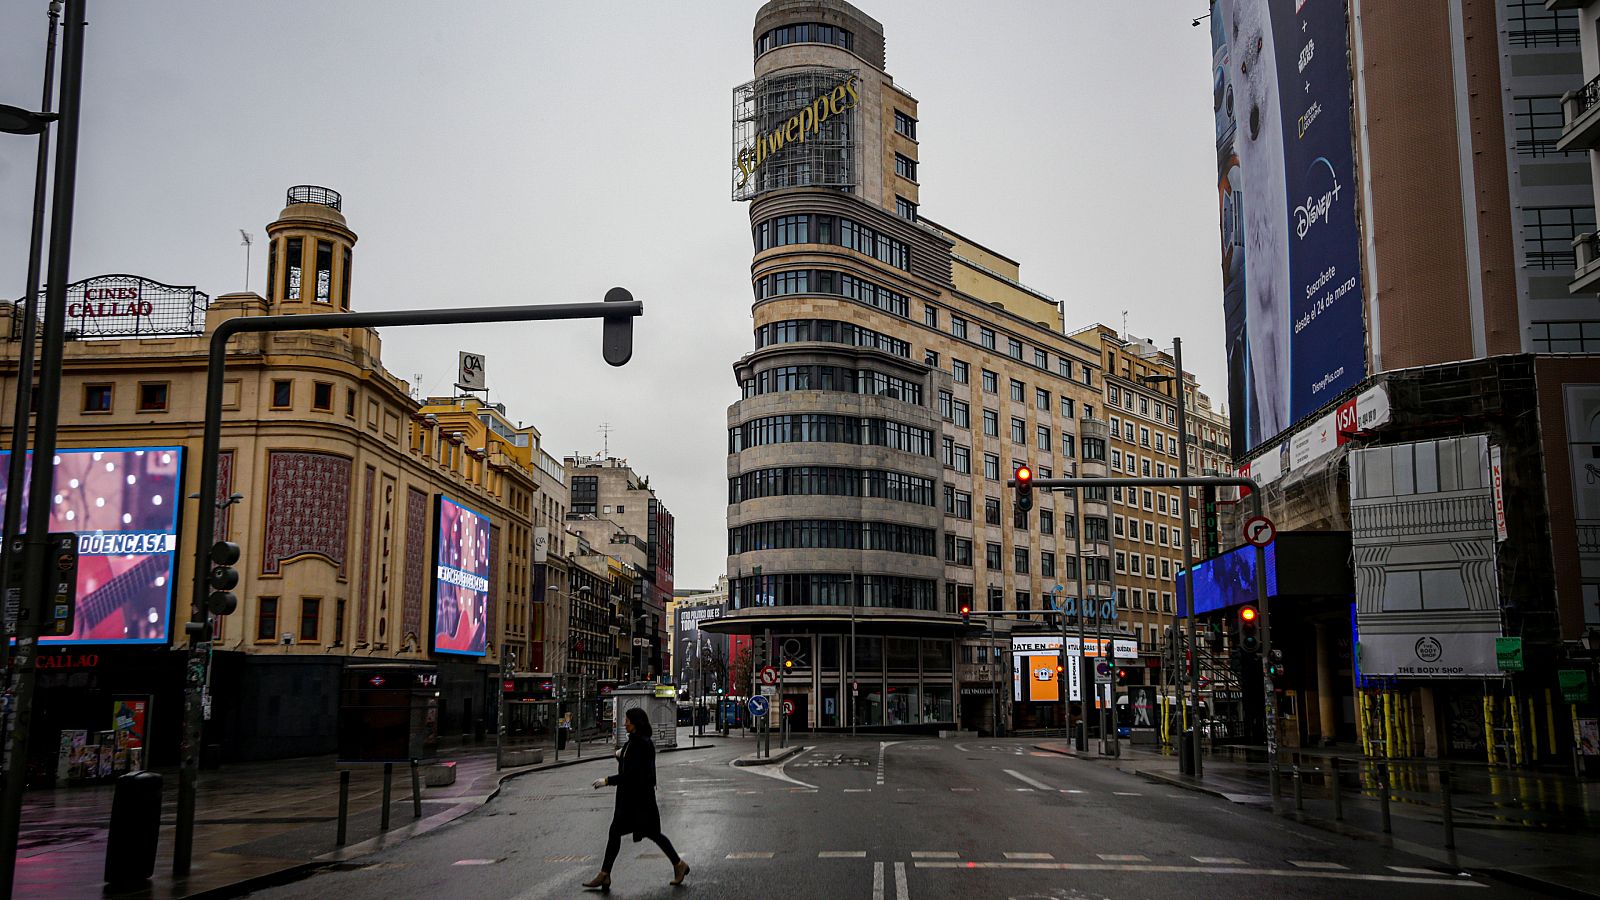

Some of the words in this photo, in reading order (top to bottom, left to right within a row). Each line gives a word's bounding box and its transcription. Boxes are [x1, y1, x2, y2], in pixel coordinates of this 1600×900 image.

[737, 76, 857, 187] Schweppes
[86, 287, 138, 301] CINES
[1294, 312, 1311, 334] desde
[1311, 303, 1317, 320] el
[1317, 297, 1325, 315] 24
[1326, 292, 1334, 307] de
[1334, 277, 1356, 301] marzo
[69, 301, 153, 318] CALLAO
[1312, 366, 1344, 394] DisneyPlus.com
[1206, 503, 1217, 557] HOTE
[379, 485, 393, 637] CALLAO
[35, 654, 101, 670] CALLAO
[1442, 666, 1464, 674] SHOP
